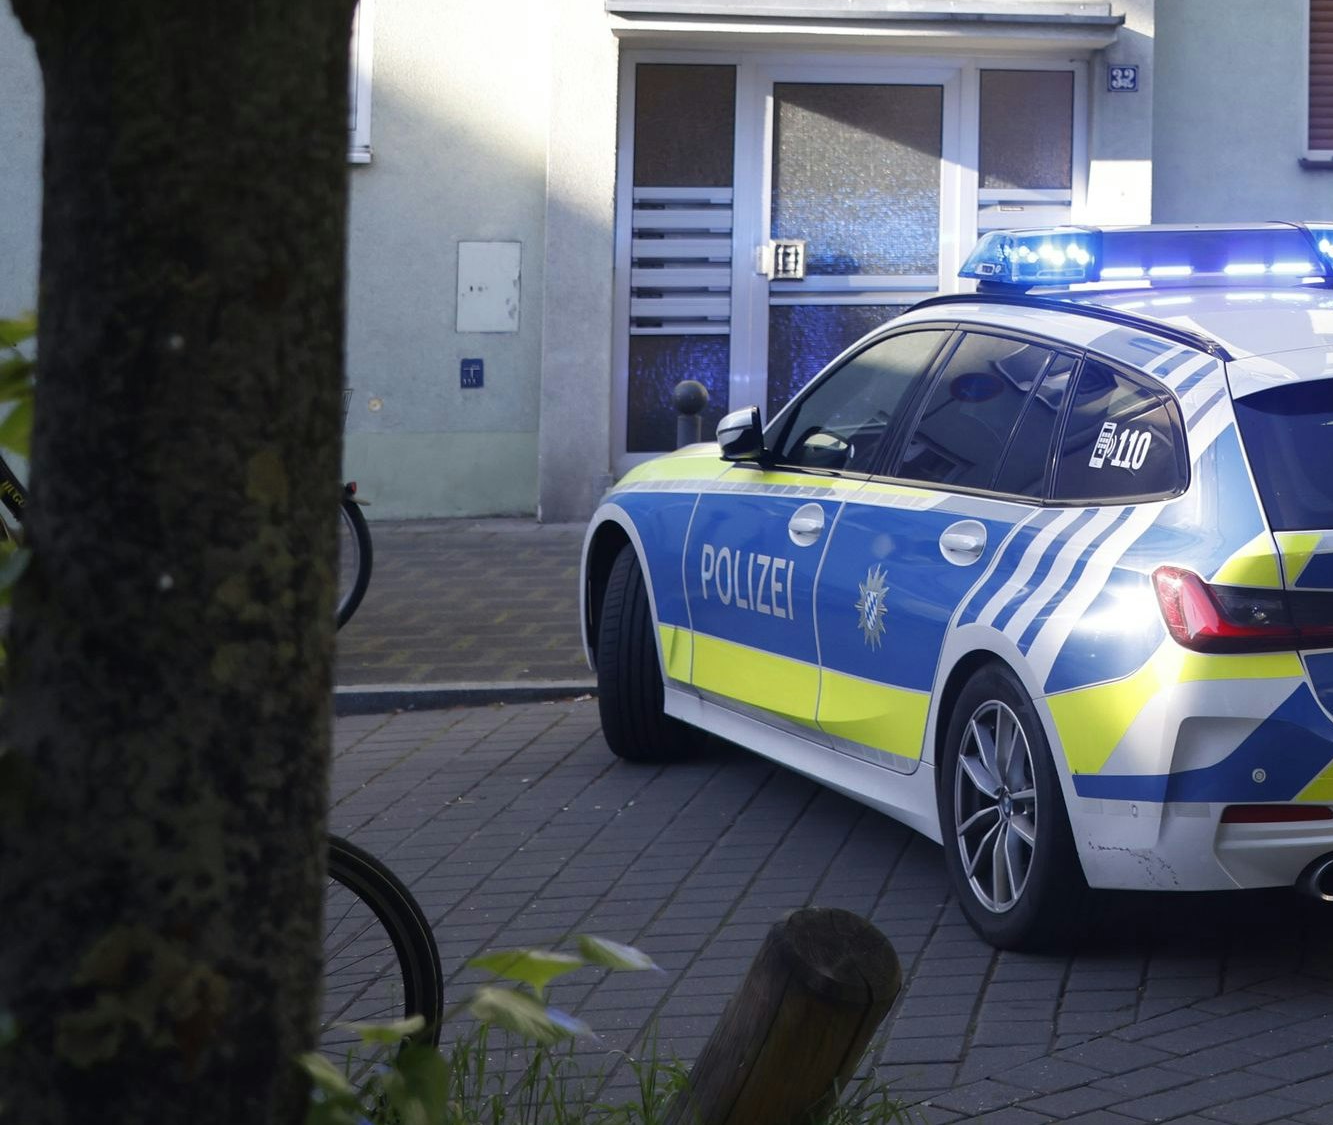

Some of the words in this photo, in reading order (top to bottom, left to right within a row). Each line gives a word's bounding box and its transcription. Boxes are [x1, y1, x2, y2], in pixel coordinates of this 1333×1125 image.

[1111, 68, 1135, 89] 32
[1110, 429, 1152, 470] 110
[701, 543, 795, 620] POLIZEI
